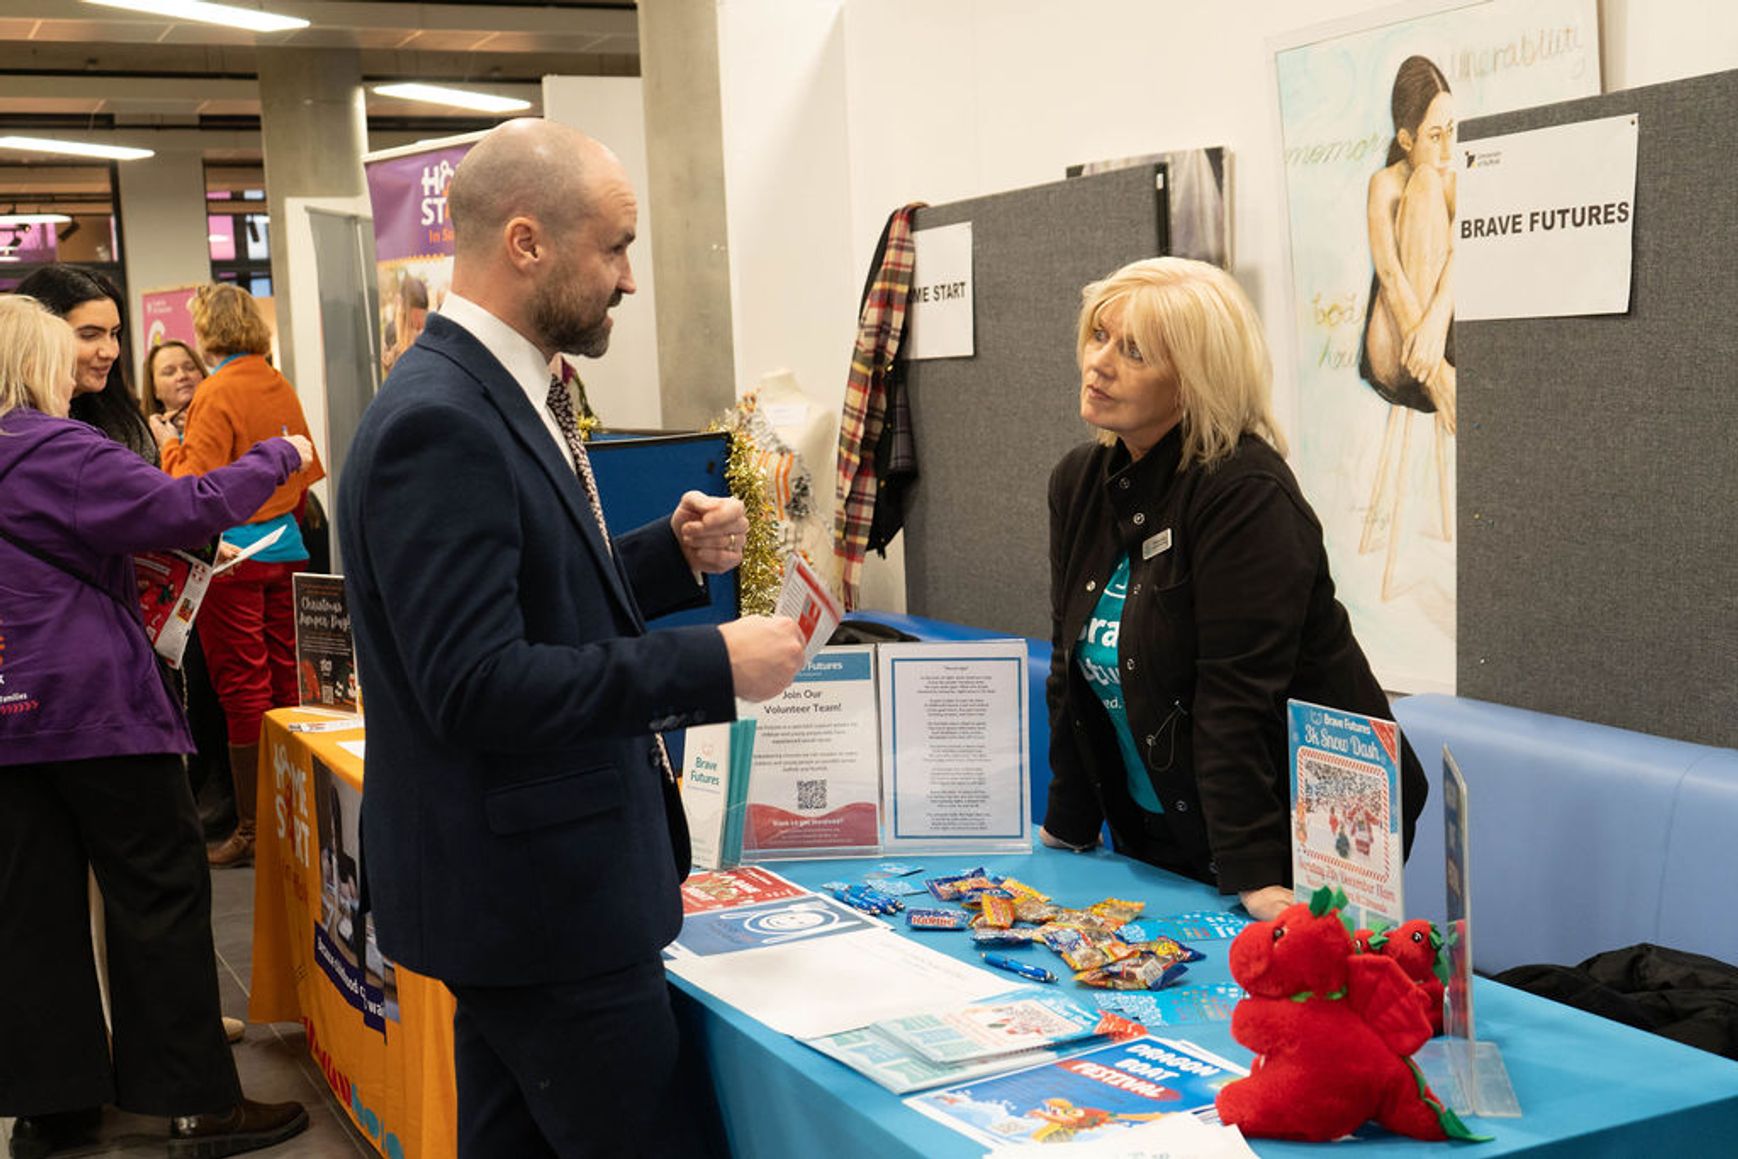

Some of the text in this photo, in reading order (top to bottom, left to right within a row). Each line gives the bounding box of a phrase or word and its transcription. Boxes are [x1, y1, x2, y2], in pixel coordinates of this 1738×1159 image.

[1461, 202, 1630, 239] BRAVE FUTURES
[911, 282, 966, 303] ME START
[783, 689, 822, 699] Join Our
[764, 703, 842, 714] Volunteer Team!
[1324, 713, 1371, 735] Brave Futures
[1321, 728, 1349, 752] Snow
[1350, 735, 1380, 761] Dash
[695, 756, 718, 770] Brave
[690, 770, 720, 786] Futures
[1114, 1058, 1180, 1082] BOAT
[1125, 1043, 1221, 1077] DRAGON
[1072, 1062, 1166, 1098] FESTIVAL
